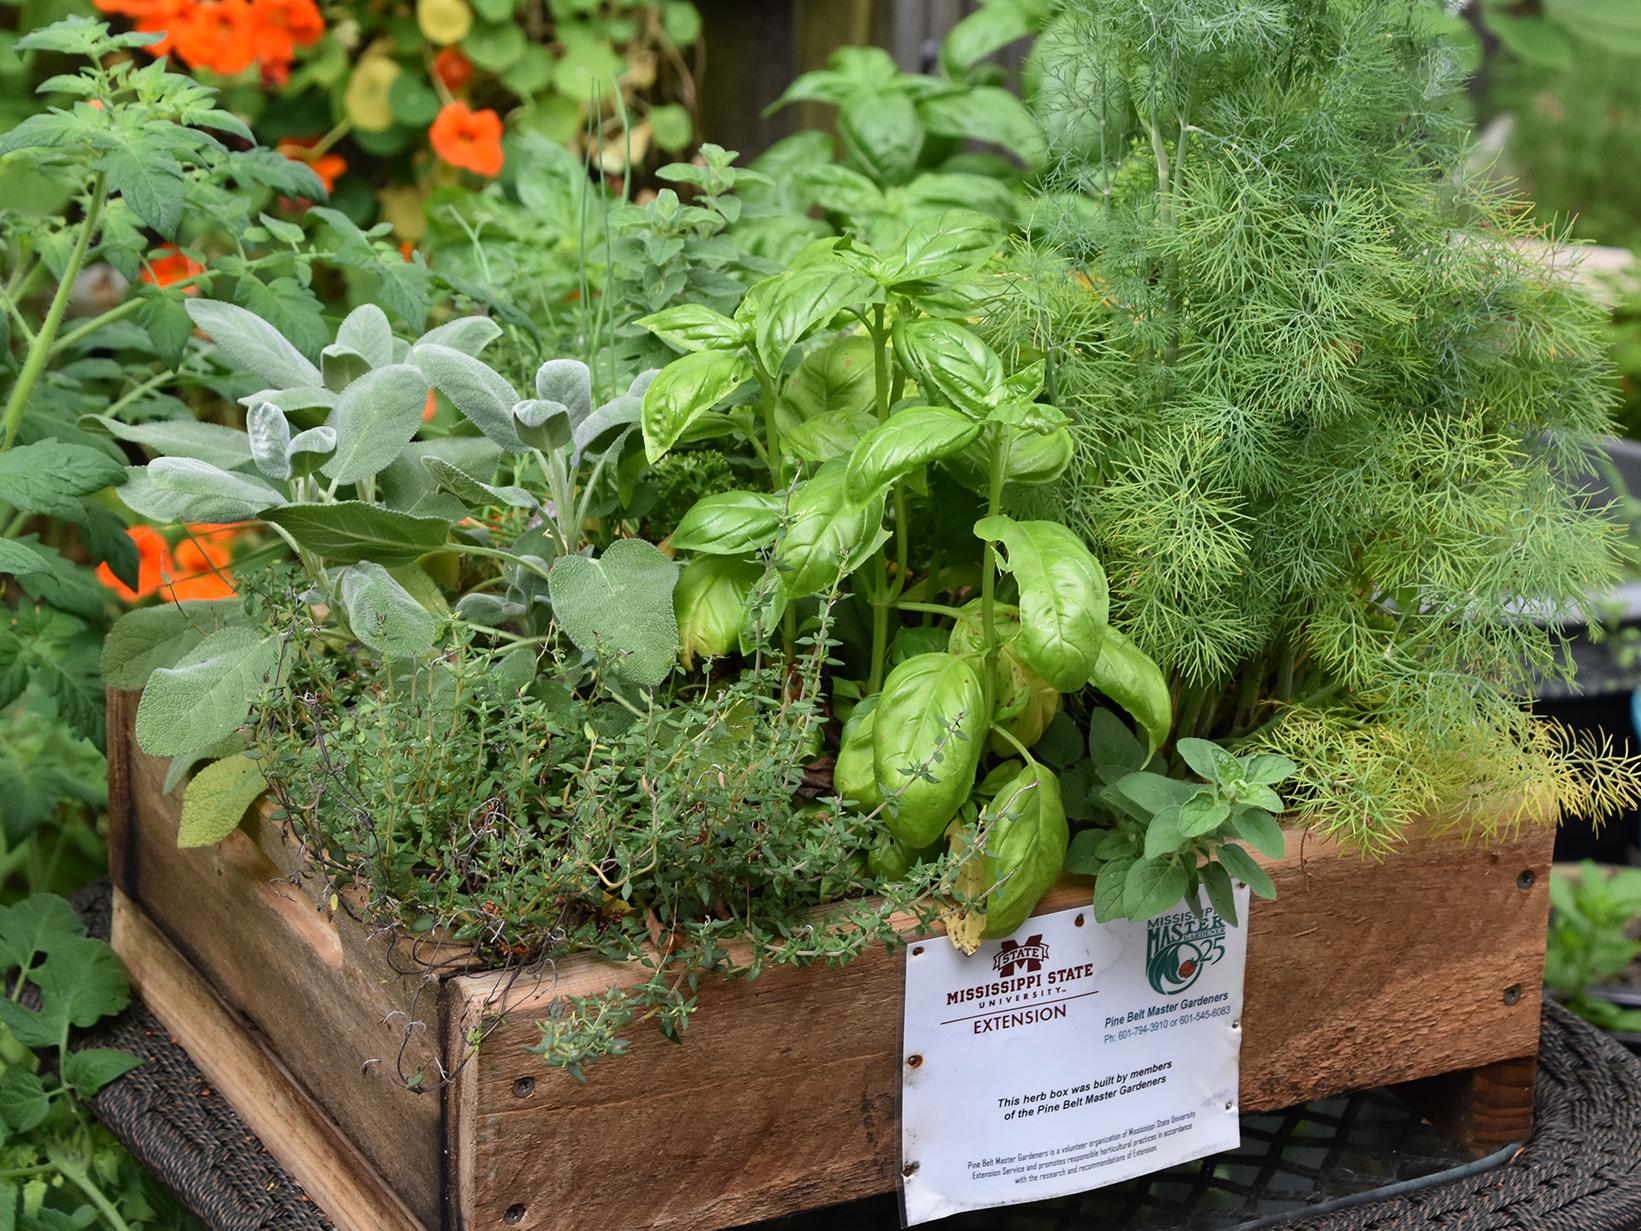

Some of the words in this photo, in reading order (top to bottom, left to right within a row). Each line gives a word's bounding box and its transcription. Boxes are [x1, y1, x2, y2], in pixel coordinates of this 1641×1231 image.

[1002, 948, 1039, 964] STATE
[1200, 936, 1225, 965] 25
[947, 975, 1041, 1005] MISSISSIPPI
[1048, 963, 1093, 984] STATE
[979, 987, 1061, 1009] UNIVERSITY
[974, 1004, 1066, 1034] EXTENSION
[1105, 1018, 1124, 1028] Pine
[1127, 1009, 1145, 1022] Belt
[1147, 1002, 1178, 1017] Master
[1181, 992, 1229, 1009] Gardeners
[1104, 1035, 1117, 1044] Ph:
[1118, 1019, 1168, 1040] 601-794-3910
[1170, 1018, 1177, 1027] or
[998, 1097, 1020, 1108] This
[1023, 1091, 1047, 1104] herb
[1050, 1088, 1068, 1099] box
[1071, 1082, 1090, 1094] was
[1093, 1076, 1115, 1089] built
[1116, 1073, 1128, 1084] by
[1130, 1060, 1172, 1079] members
[1004, 1108, 1015, 1120] of
[1018, 1105, 1034, 1118] the
[1037, 1101, 1060, 1115] Pine
[1063, 1095, 1083, 1109] Belt
[1085, 1088, 1117, 1104] Master
[1120, 1075, 1167, 1095] Gardeners
[968, 1161, 981, 1169] Pine
[982, 1159, 994, 1167] Belt
[996, 1156, 1016, 1165] Master
[1018, 1151, 1048, 1161] Gardeners
[1062, 1142, 1088, 1153] volunteer
[1089, 1133, 1121, 1147] organization
[1122, 1130, 1128, 1138] of
[1157, 1119, 1170, 1128] State
[1171, 1111, 1196, 1124] University
[972, 1169, 1000, 1180] Extension
[1002, 1165, 1025, 1175] Service
[1027, 1162, 1037, 1171] and
[1039, 1159, 1066, 1170] promotes
[1133, 1134, 1157, 1146] practices
[1015, 1175, 1027, 1184] with
[1029, 1174, 1038, 1182] the
[1040, 1169, 1066, 1180] research
[1067, 1166, 1077, 1175] and
[1127, 1151, 1132, 1159] of
